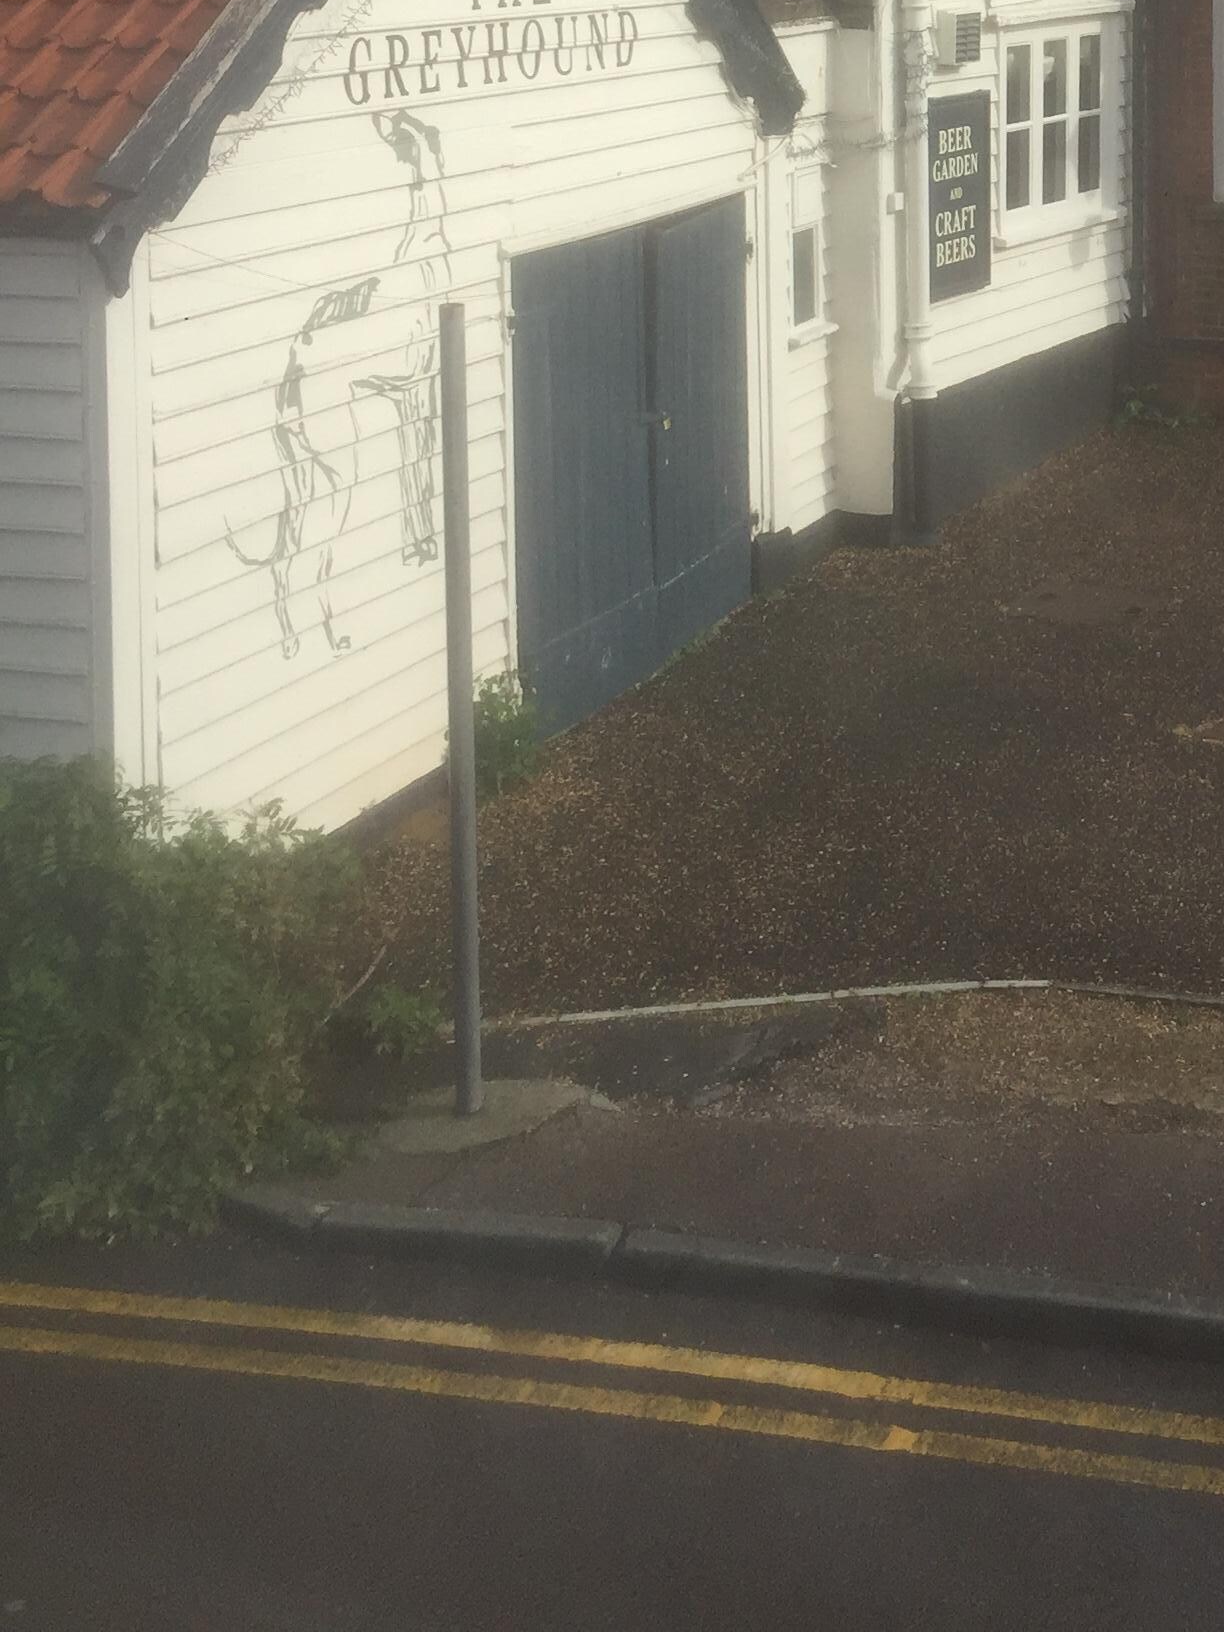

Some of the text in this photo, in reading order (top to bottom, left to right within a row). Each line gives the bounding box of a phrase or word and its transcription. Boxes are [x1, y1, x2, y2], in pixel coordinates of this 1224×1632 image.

[343, 10, 638, 105] GREYHOUND
[938, 125, 972, 155] BEER
[932, 152, 978, 182] GARDEN
[950, 186, 963, 200] AND
[935, 205, 976, 237] CRAFT
[936, 235, 976, 267] BEERS
